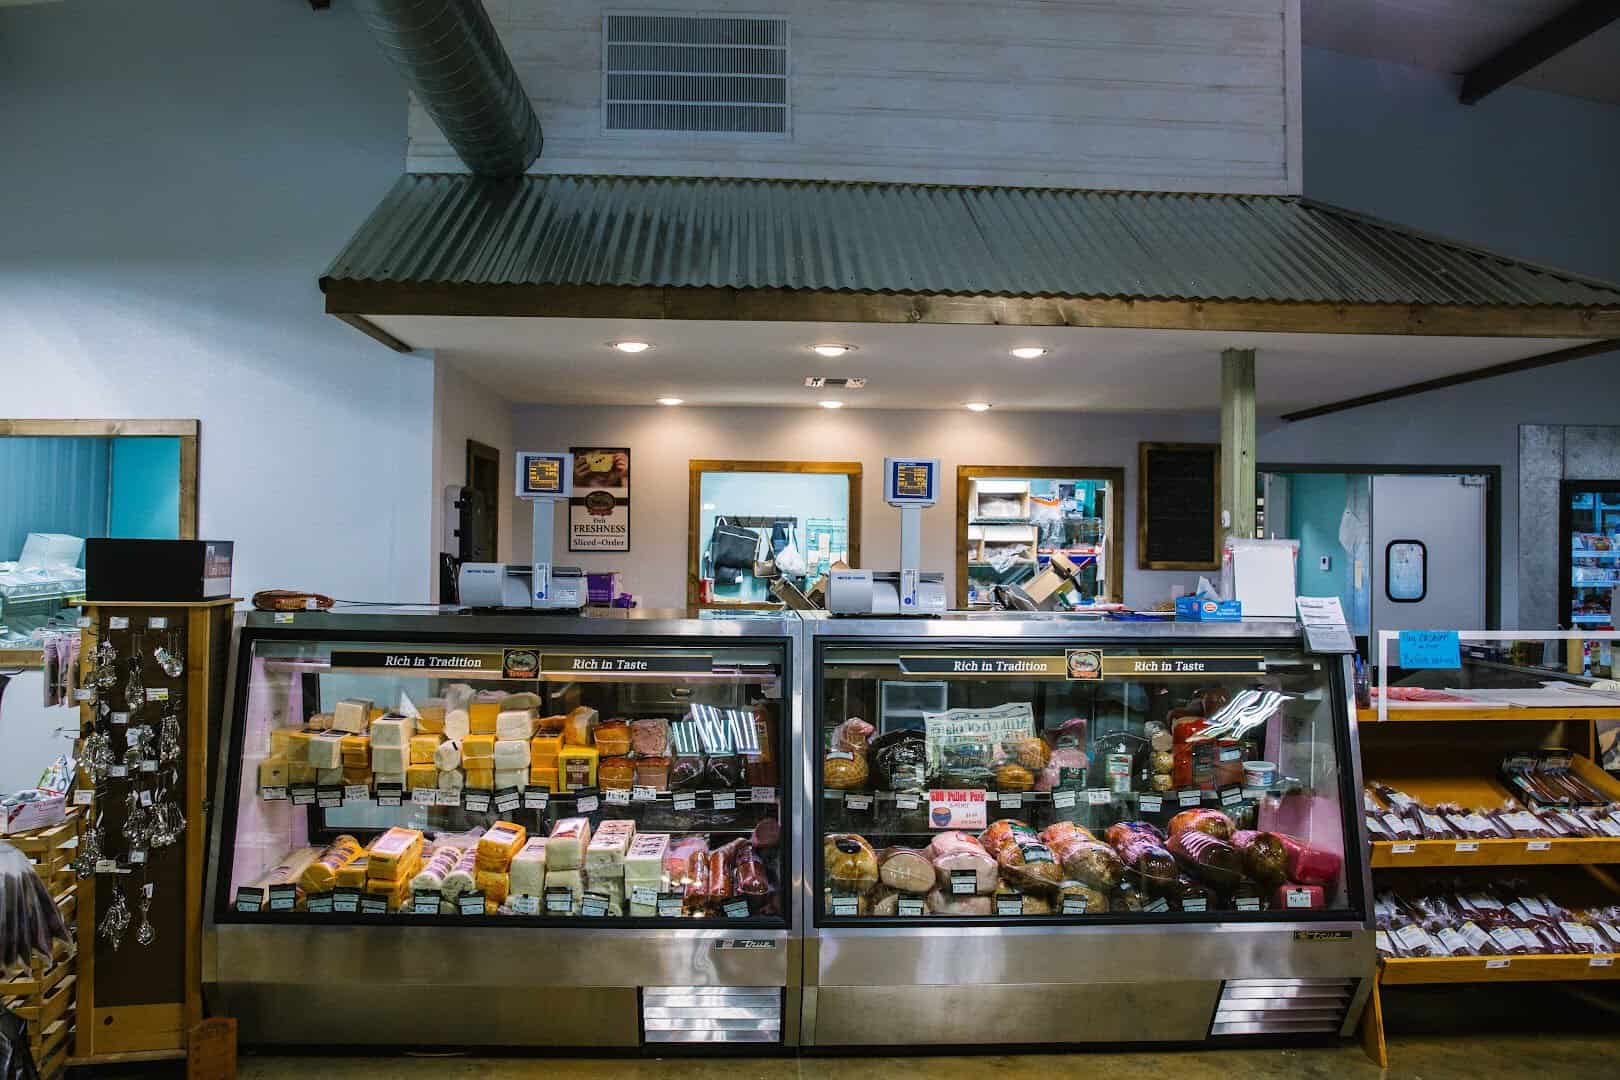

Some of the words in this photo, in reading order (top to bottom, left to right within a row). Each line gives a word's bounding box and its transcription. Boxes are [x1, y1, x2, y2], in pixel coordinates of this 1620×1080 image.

[574, 524, 626, 533] FRESHNESS
[385, 655, 410, 667] Rich
[413, 656, 425, 667] in
[430, 656, 482, 668] Tradition
[572, 658, 598, 670] Rich
[601, 659, 613, 670] in
[616, 659, 647, 670] Taste
[953, 660, 978, 671] Rich
[981, 661, 993, 671] in
[996, 661, 1047, 672] Tradition
[1134, 661, 1158, 671] Rich
[1161, 662, 1172, 671] in
[1175, 661, 1205, 671] Taste
